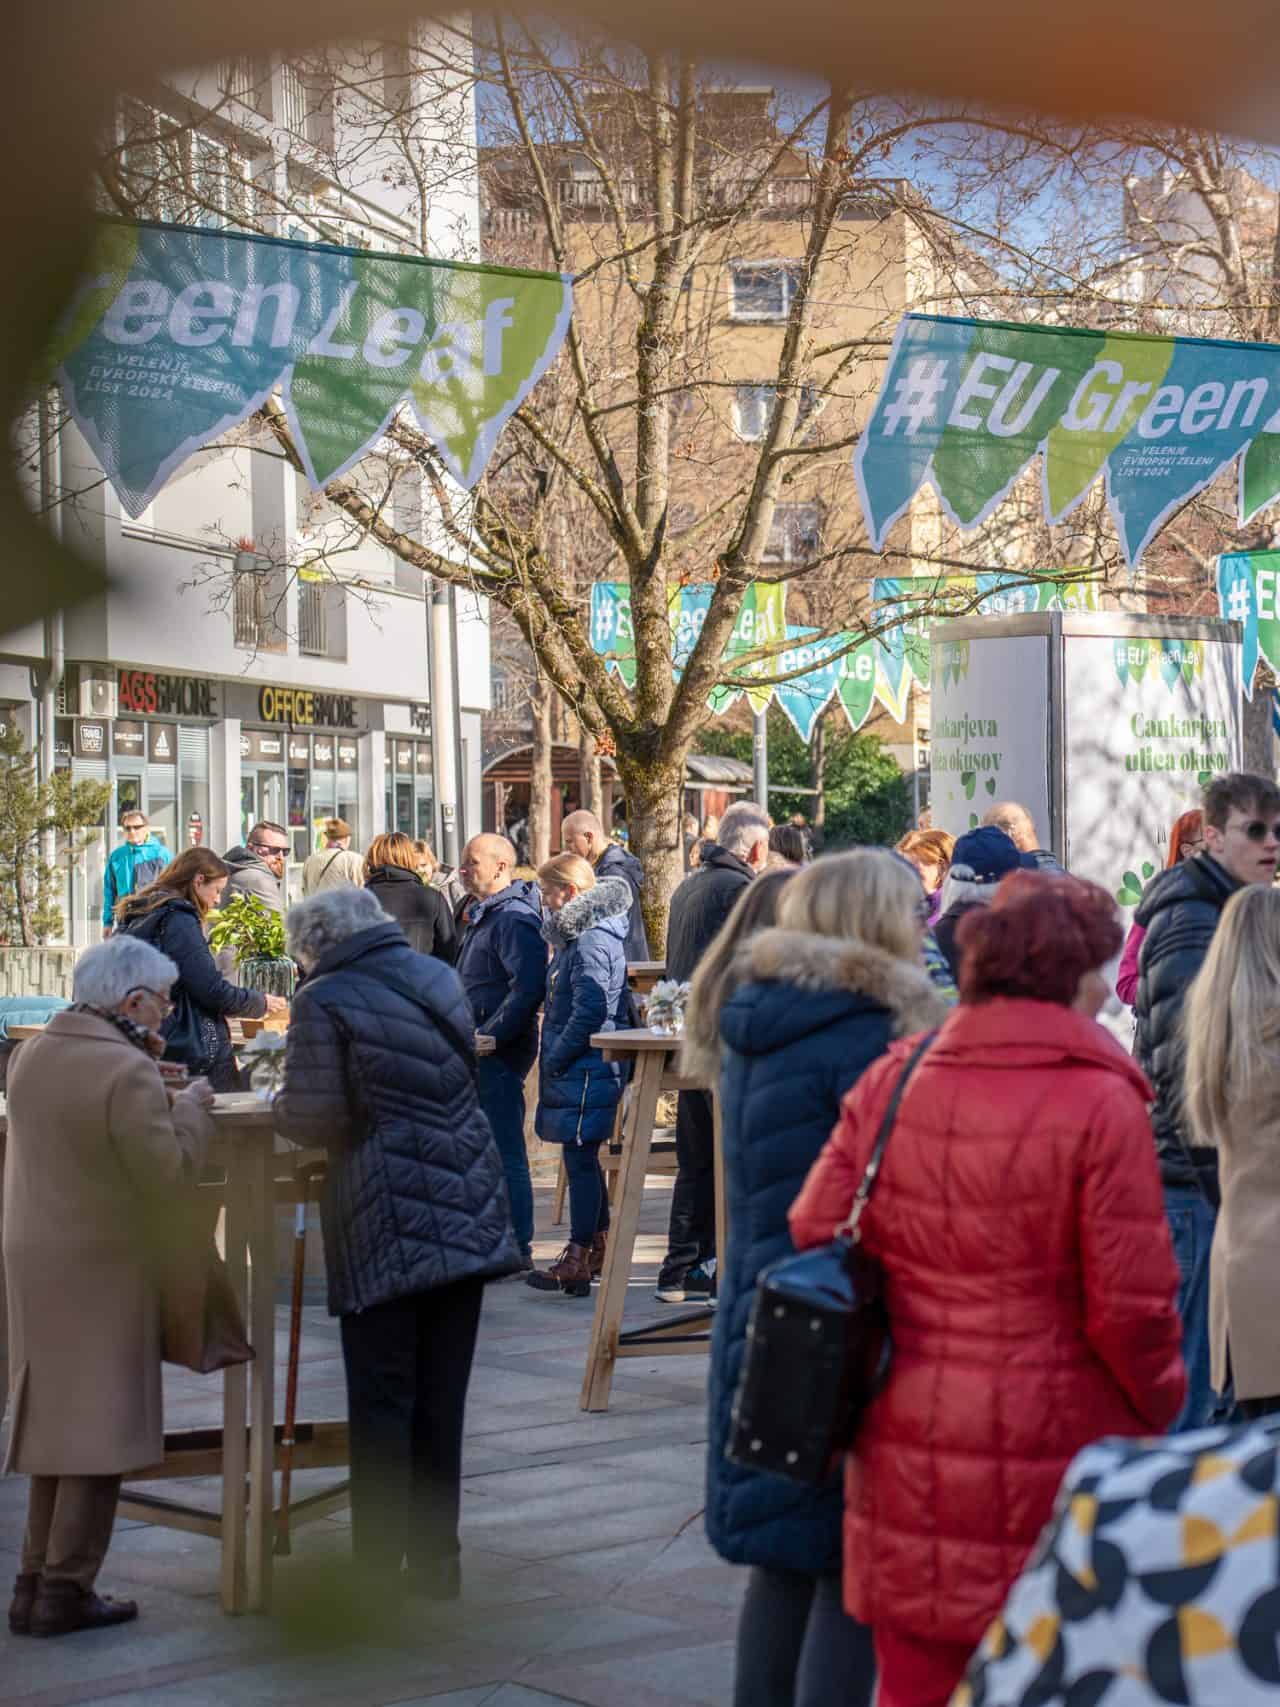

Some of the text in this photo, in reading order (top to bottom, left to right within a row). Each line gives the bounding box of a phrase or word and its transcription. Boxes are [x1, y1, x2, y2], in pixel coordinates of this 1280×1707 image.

[305, 280, 515, 383] Leaf
[882, 351, 1061, 437] #EU
[1061, 359, 1269, 439] Green
[596, 598, 635, 641] #E
[1125, 746, 1176, 772] ulica
